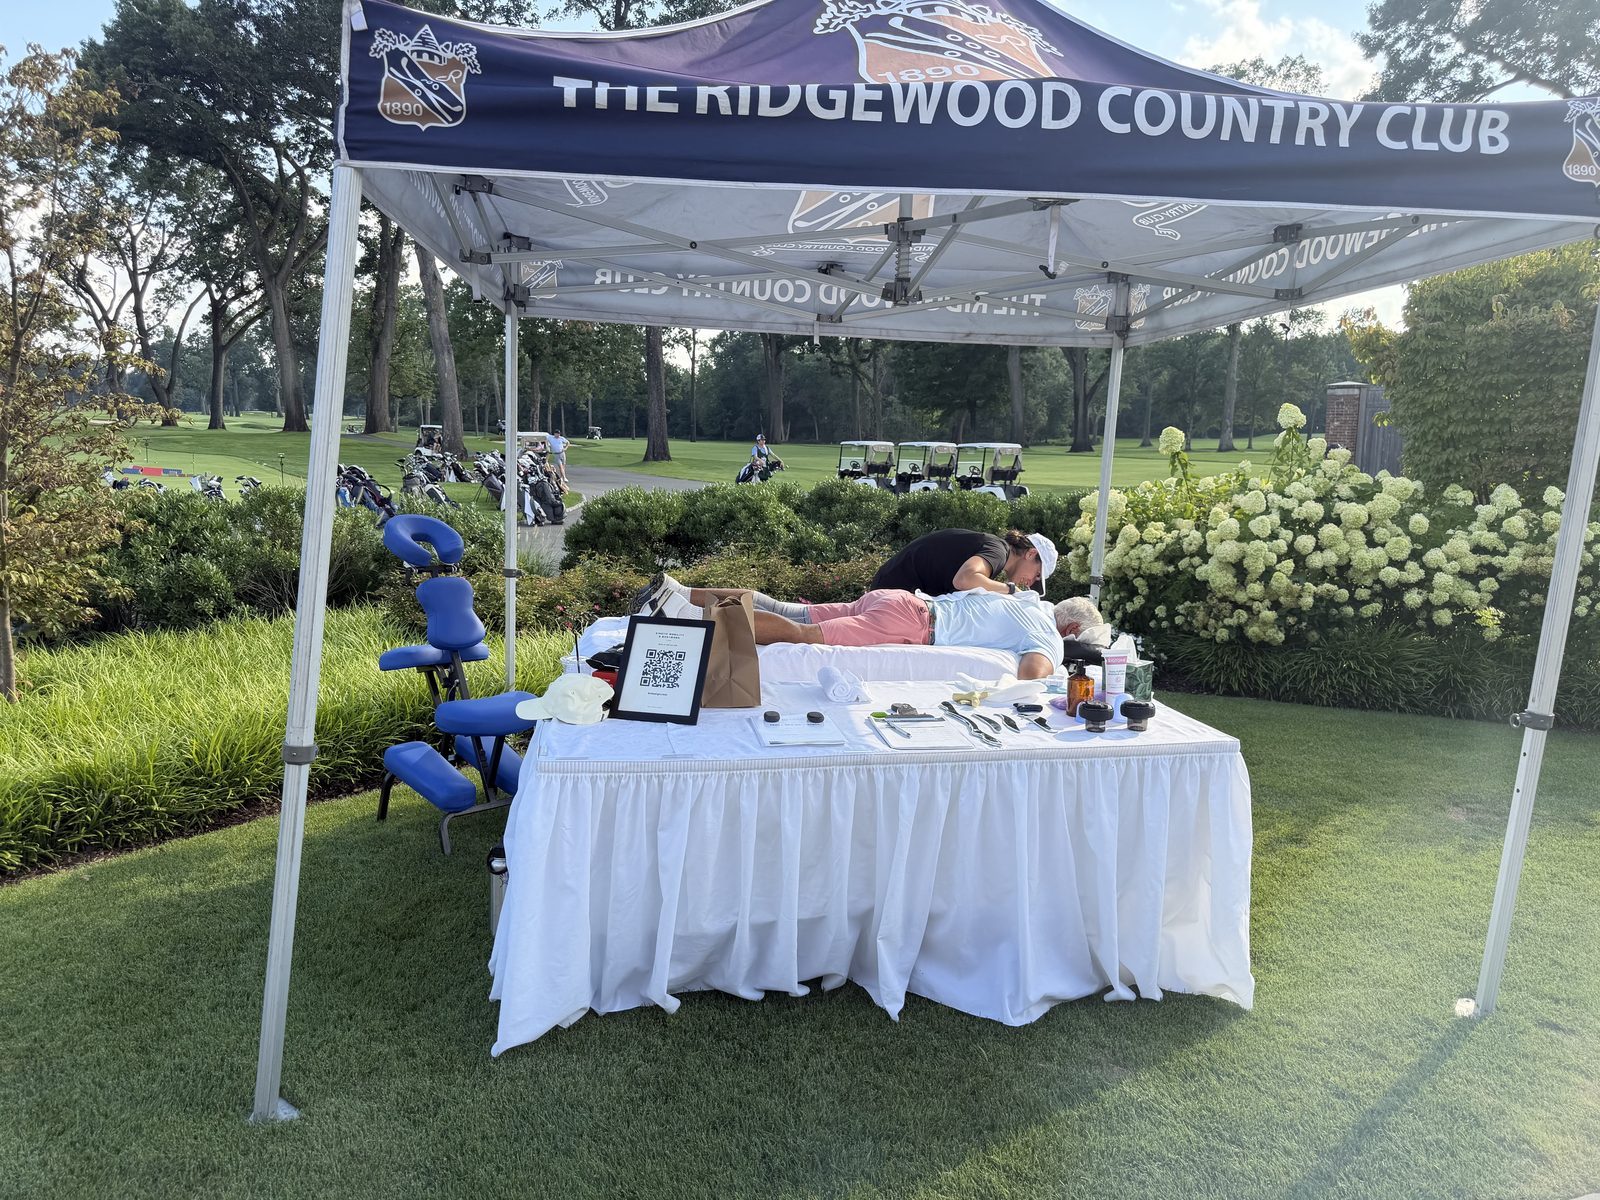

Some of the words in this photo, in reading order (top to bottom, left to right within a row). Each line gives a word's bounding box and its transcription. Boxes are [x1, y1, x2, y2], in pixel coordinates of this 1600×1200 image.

[878, 64, 981, 83] 1890
[384, 101, 424, 117] 1890
[552, 75, 679, 114] THE
[695, 79, 1082, 130] RIDGEWOOD
[1097, 85, 1364, 148] COUNTRY
[1376, 105, 1510, 155] CLUB
[1566, 164, 1597, 177] 1890
